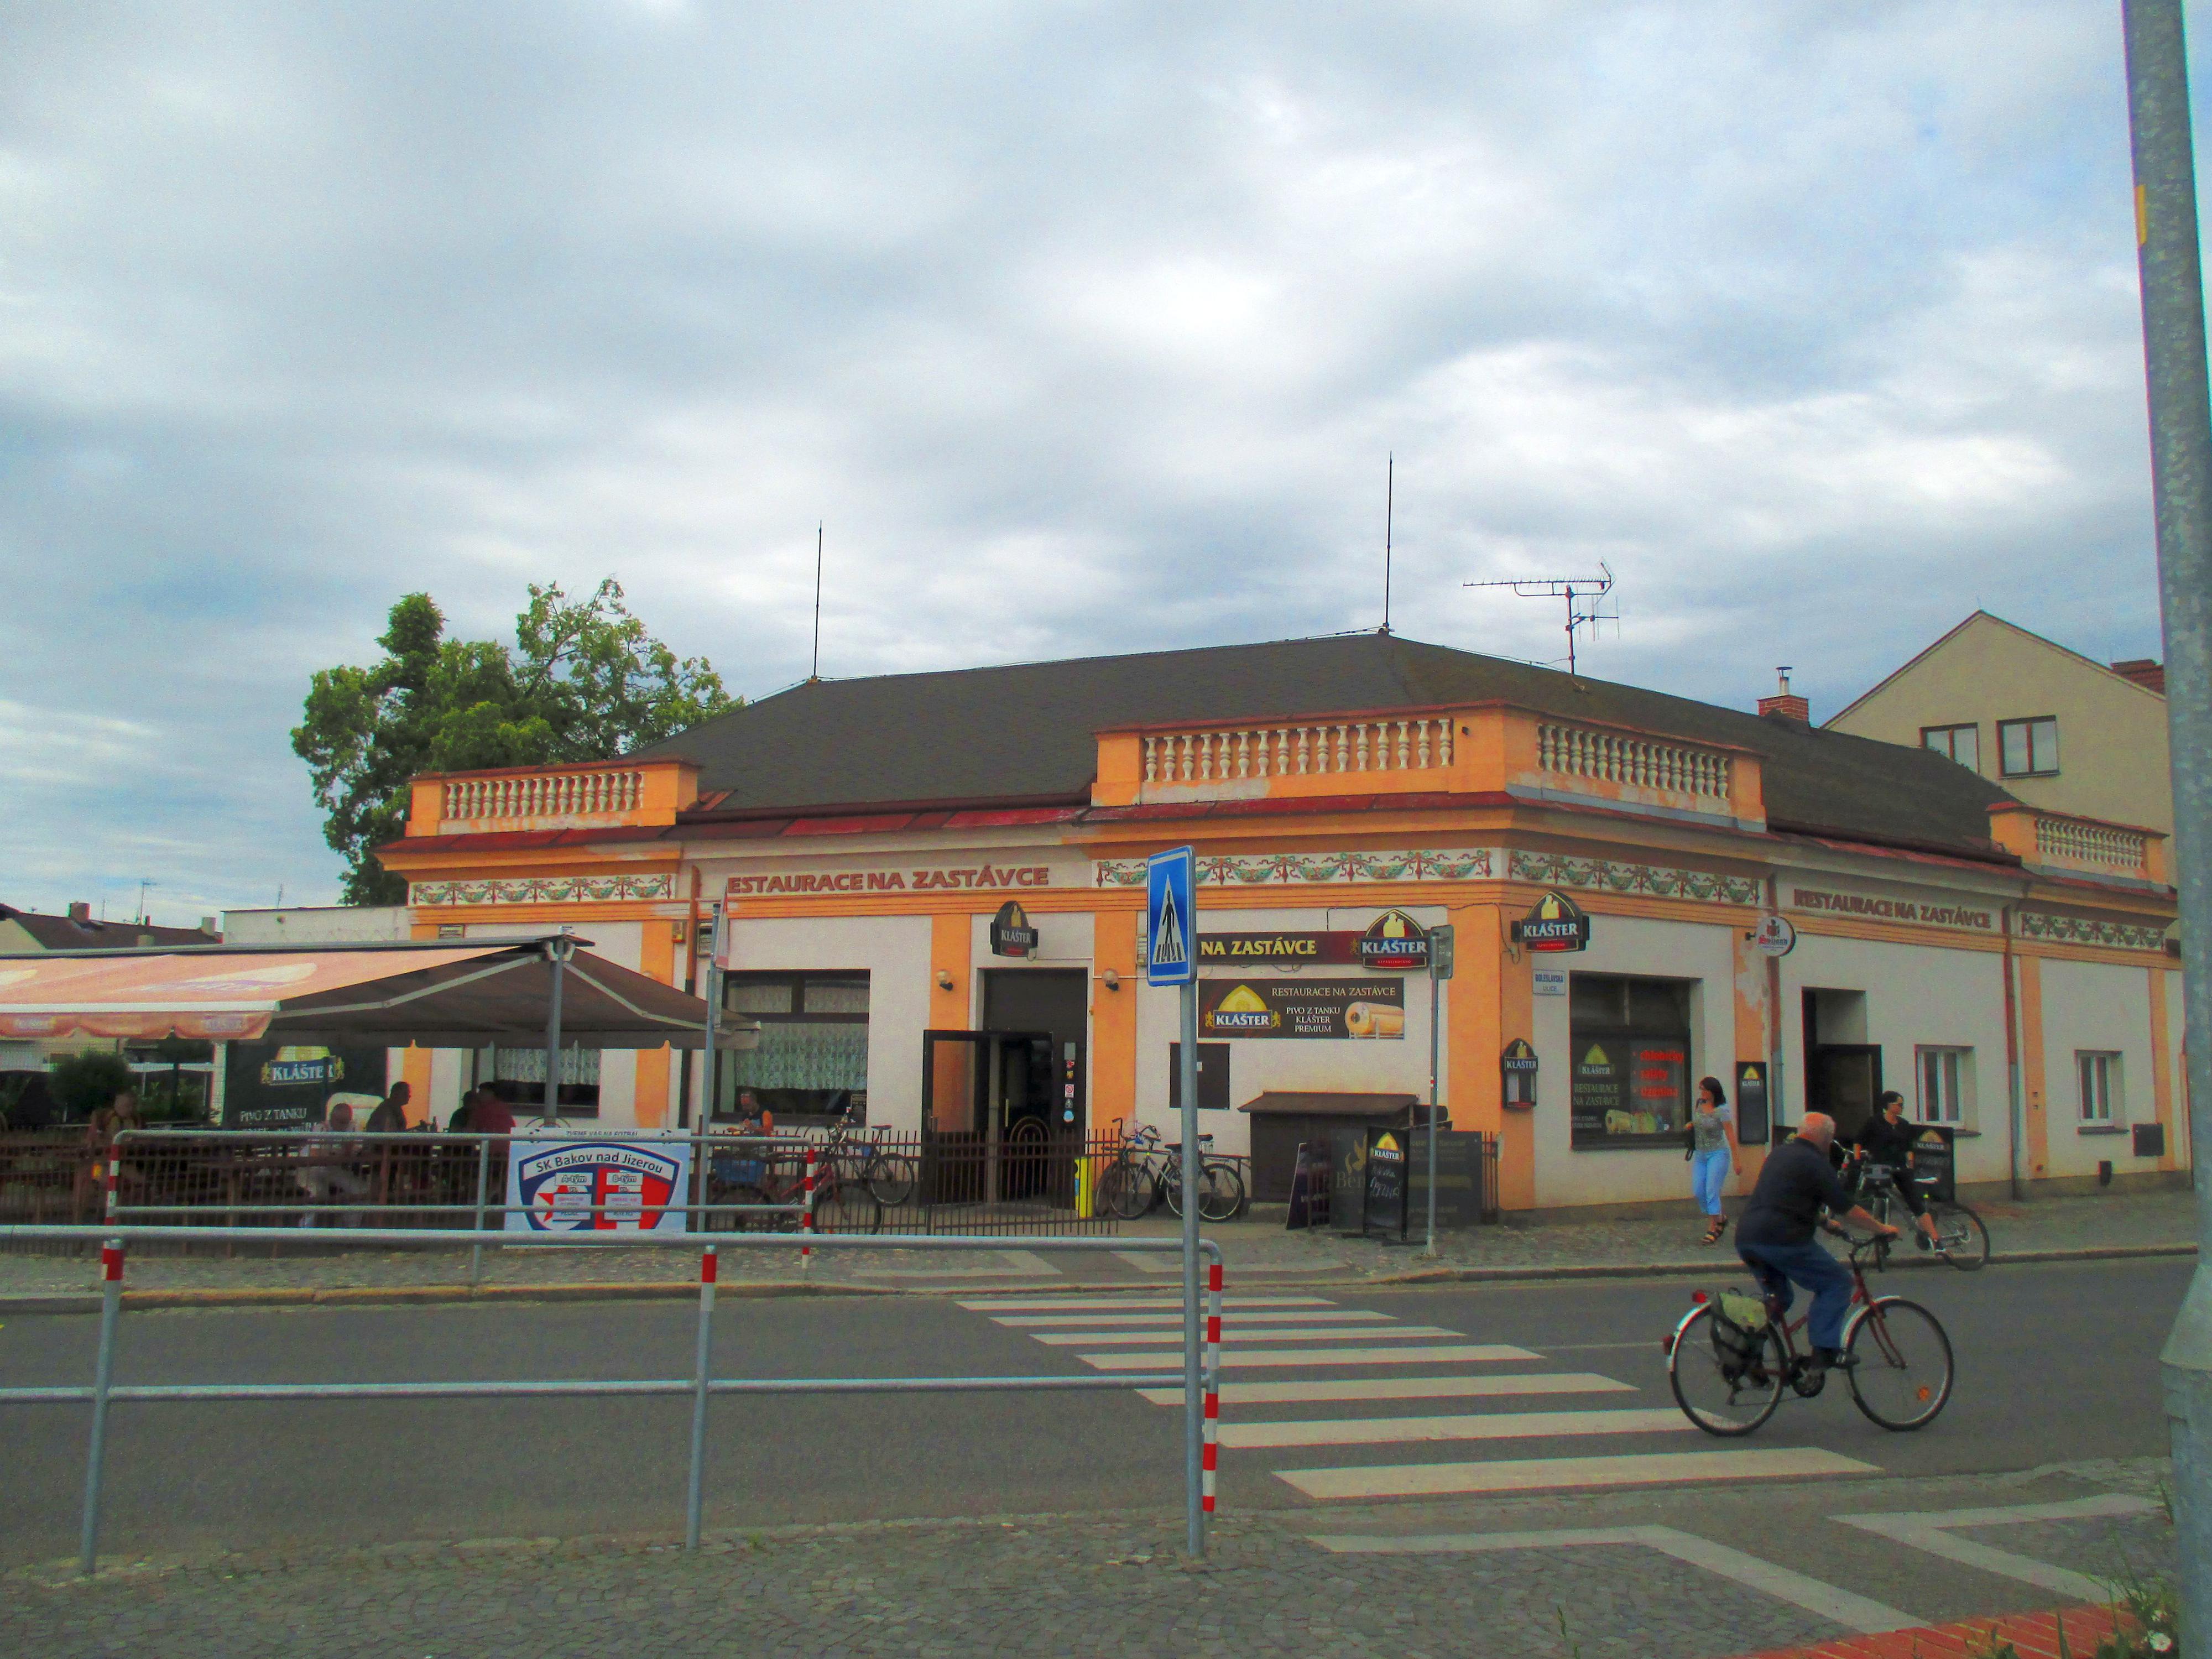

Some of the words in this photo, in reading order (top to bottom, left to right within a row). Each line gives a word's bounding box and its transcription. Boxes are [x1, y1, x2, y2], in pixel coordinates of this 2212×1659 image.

[868, 872, 905, 890] NA
[912, 865, 1049, 889] ZASTÁVCE
[1794, 889, 1893, 917] RESTAURACE
[1895, 902, 1916, 920] NA
[1920, 906, 1991, 928] ZASTÁVCE
[1001, 929, 1031, 943] KLÁŠTER
[1524, 923, 1578, 937] KLÁŠTER
[1201, 941, 1226, 956] NA
[1230, 937, 1317, 956] ZASTÁVCE
[1362, 938, 1428, 953] KLÁŠTER
[1272, 988, 1330, 996] RESTAURACE
[1333, 988, 1346, 996] NA
[1349, 985, 1395, 996] ZASTÁVCE
[1217, 1013, 1269, 1026] KLÁŠTER
[1296, 1014, 1331, 1023] KLÁŠTER
[1507, 1060, 1537, 1068] KLÁŠTER
[1582, 1066, 1610, 1074] KLÁŠTER
[1574, 1084, 1619, 1093] RESTAURACE
[1573, 1097, 1583, 1105] NA
[1586, 1096, 1619, 1105] ZASTÁVCE
[274, 1108, 307, 1120] TANKU
[536, 1161, 552, 1172] SK
[555, 1154, 592, 1167] Bakov
[597, 1152, 619, 1162] nad
[622, 1153, 663, 1173] Jizerou
[561, 1173, 587, 1183] A-tým
[612, 1173, 638, 1183] B-tým
